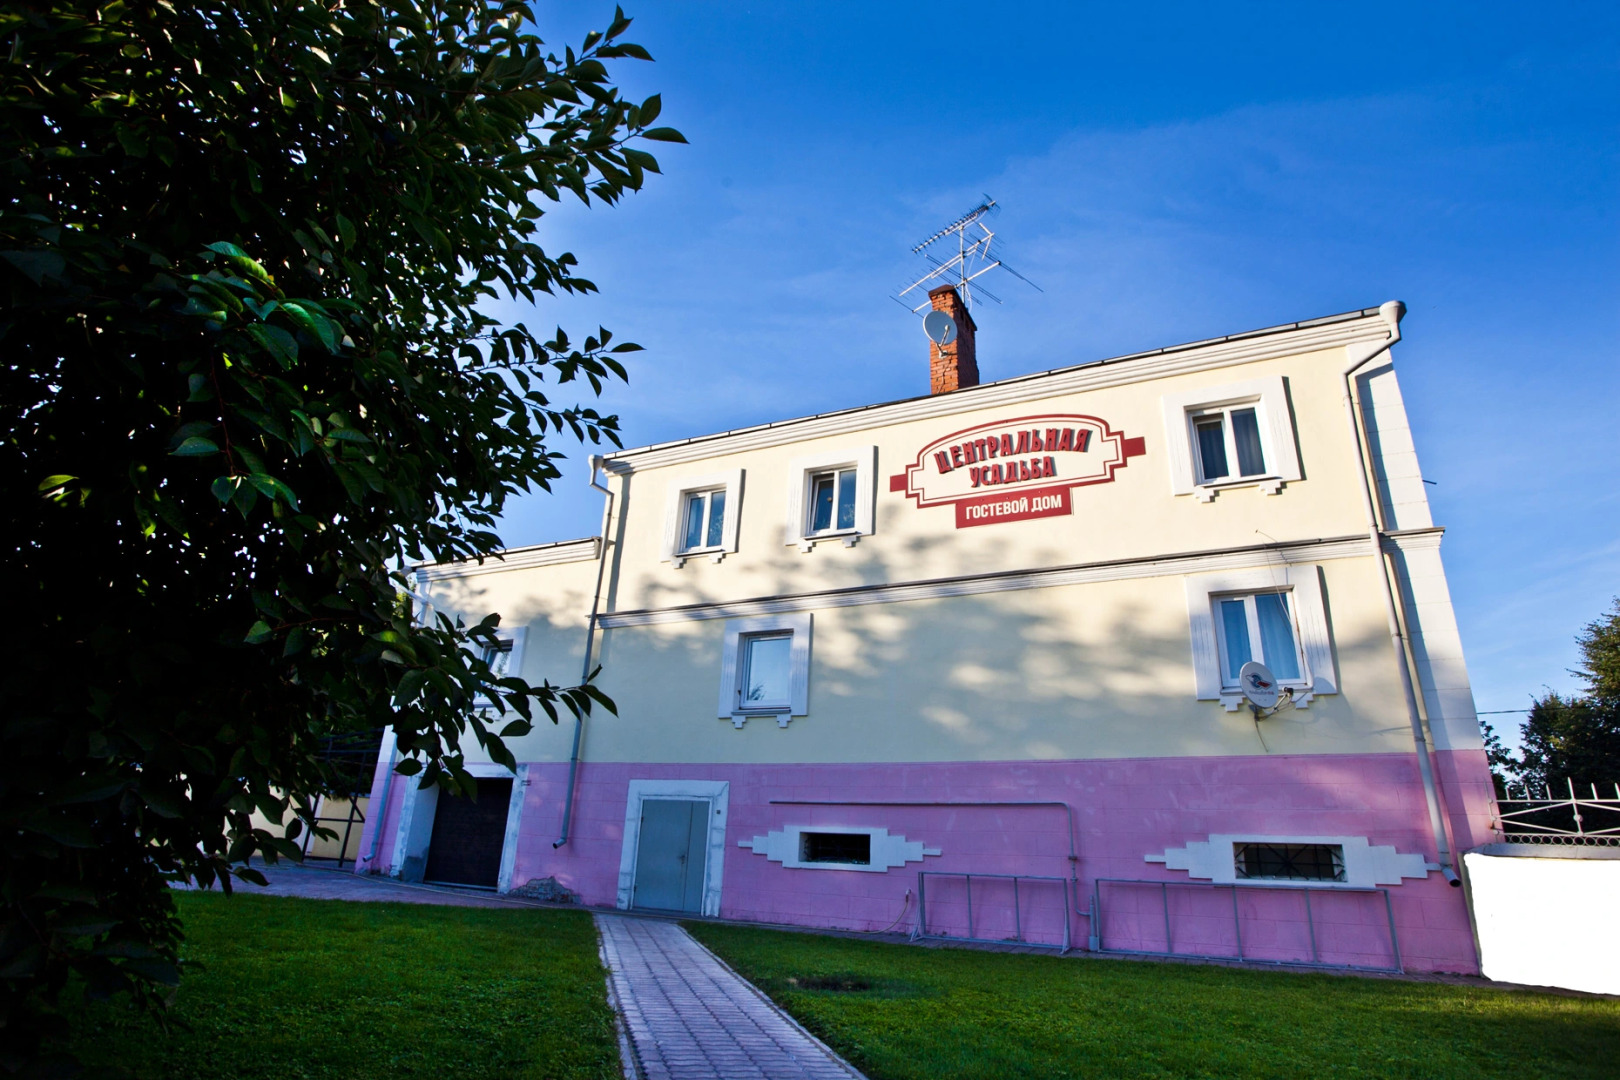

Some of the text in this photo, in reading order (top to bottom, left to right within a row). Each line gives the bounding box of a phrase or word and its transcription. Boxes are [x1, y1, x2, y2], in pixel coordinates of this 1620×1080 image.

[934, 428, 1092, 474] ЦЕНТРАЛЬНАЯ
[969, 455, 1055, 488] УСАДЬБА
[965, 494, 1062, 520] ГОСТЕВОЙ ДОМ
